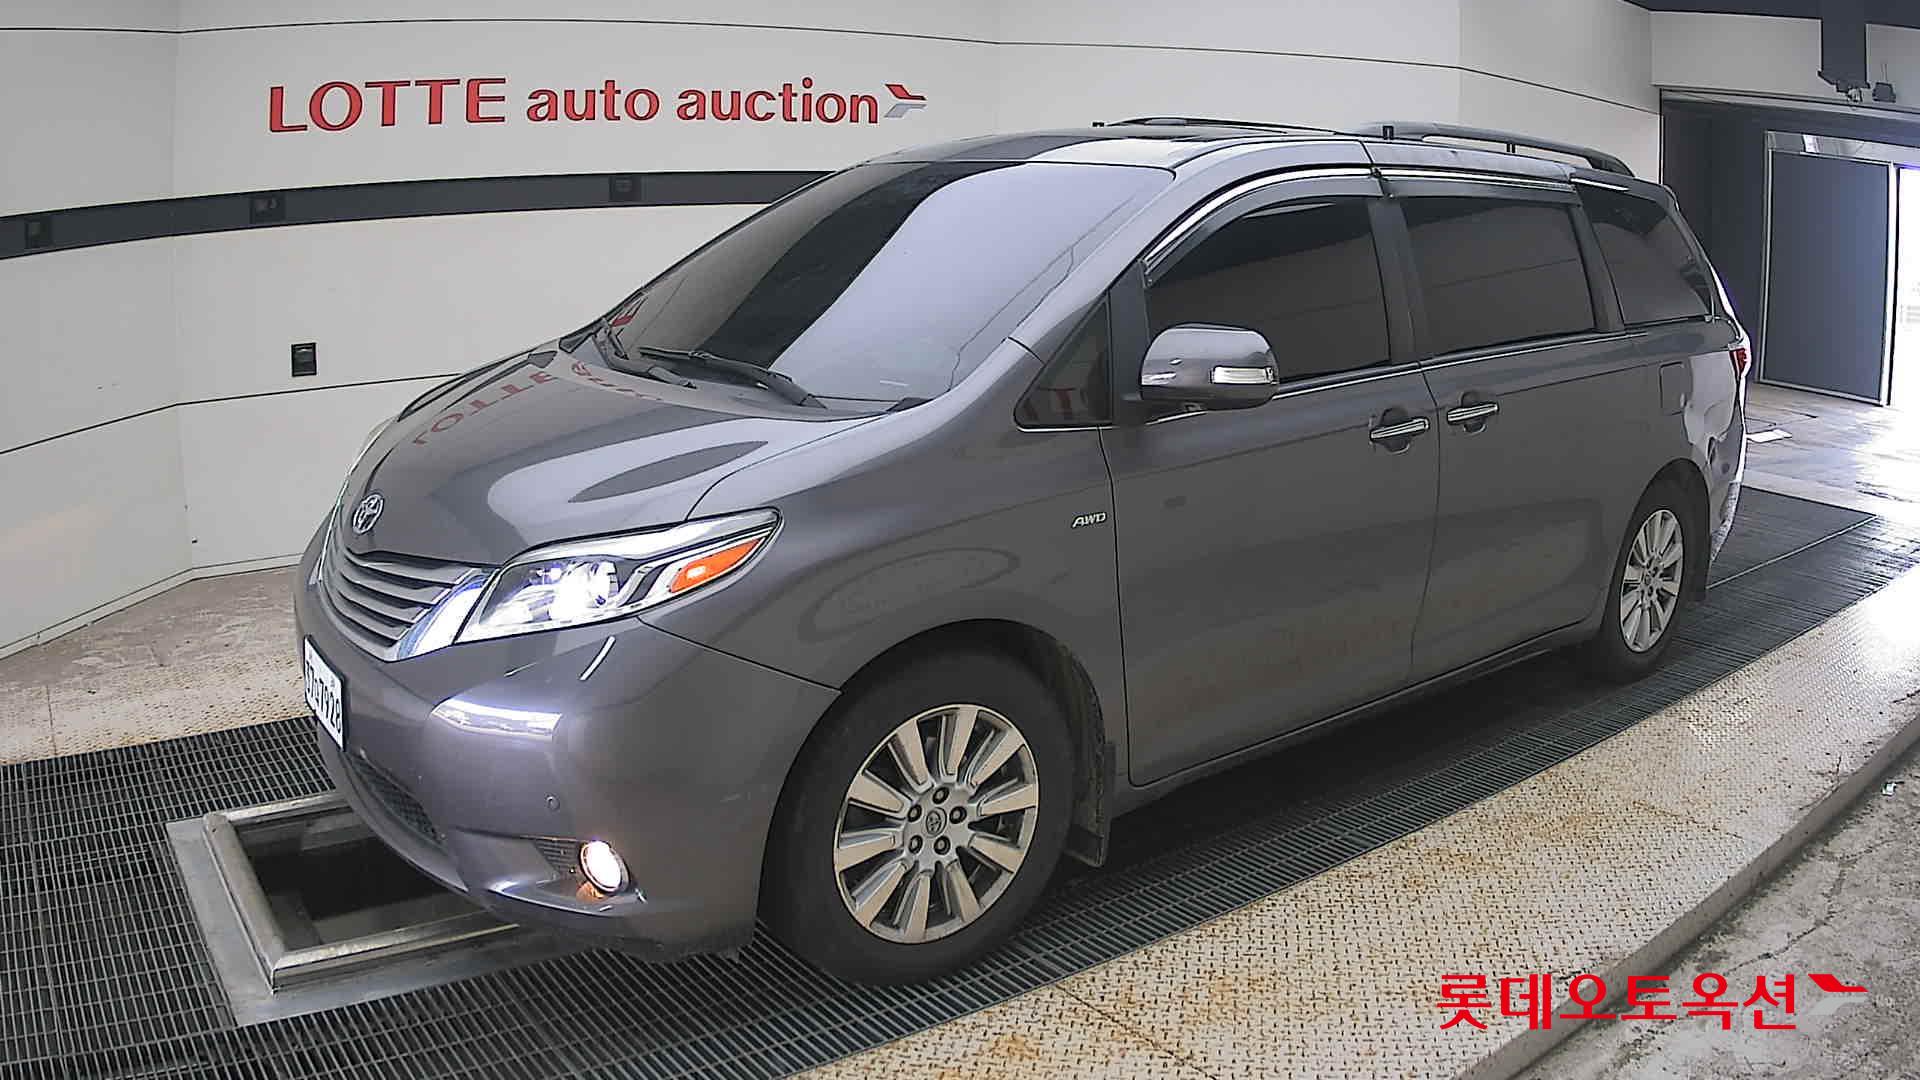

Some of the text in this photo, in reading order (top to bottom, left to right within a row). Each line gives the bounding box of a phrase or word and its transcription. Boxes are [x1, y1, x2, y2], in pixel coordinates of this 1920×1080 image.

[269, 77, 879, 133] LOTTE auto auction
[1072, 511, 1106, 529] AWD
